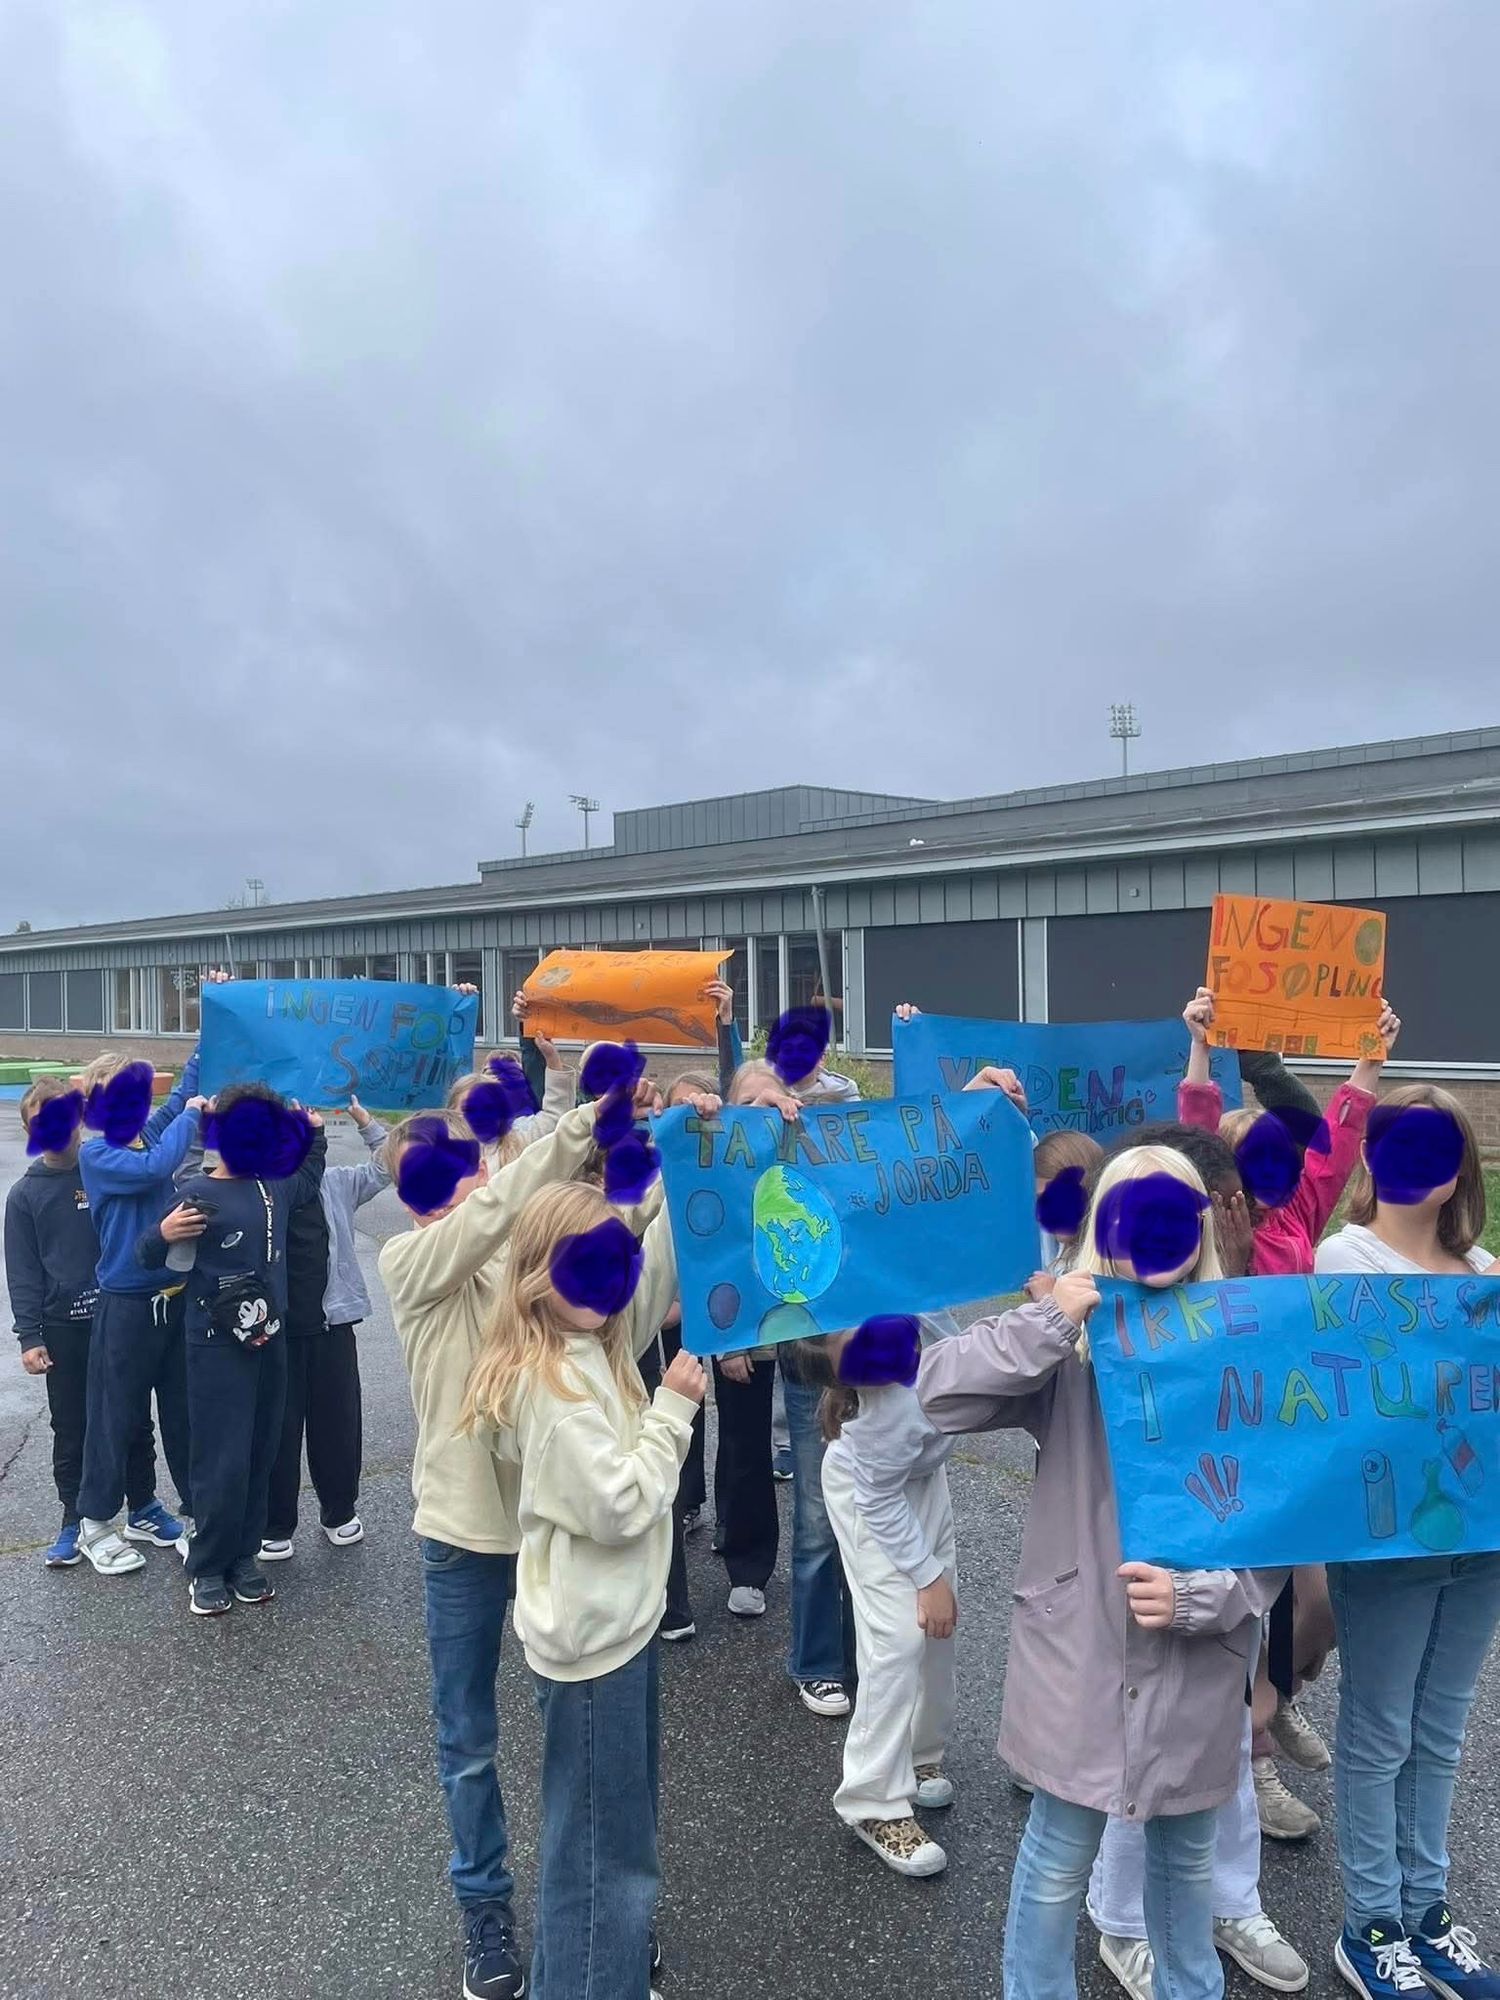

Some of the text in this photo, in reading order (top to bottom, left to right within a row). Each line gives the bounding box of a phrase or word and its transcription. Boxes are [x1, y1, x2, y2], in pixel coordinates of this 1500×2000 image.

[1212, 895, 1356, 951] INGEN
[937, 1056, 1126, 1112] VDEN
[685, 1116, 757, 1168] TA
[763, 1110, 879, 1166] VARE
[899, 1096, 962, 1154] PÅ
[875, 1152, 989, 1216] JORDA
[1137, 1351, 1500, 1442] I NATURE
